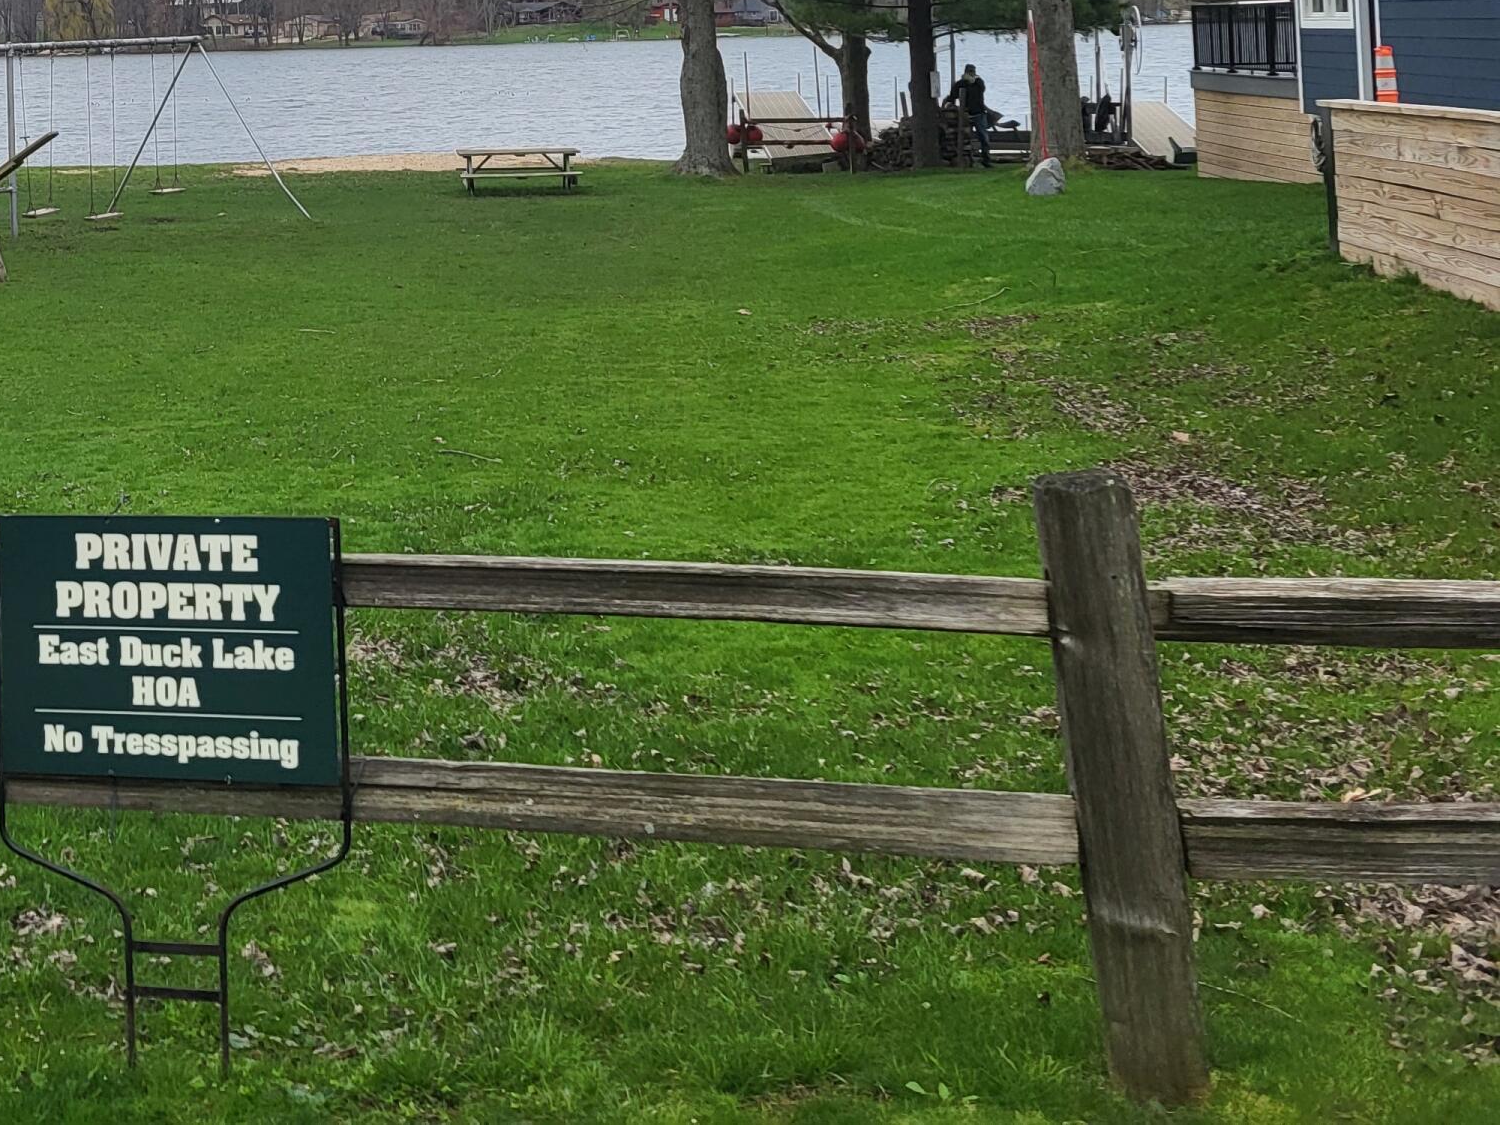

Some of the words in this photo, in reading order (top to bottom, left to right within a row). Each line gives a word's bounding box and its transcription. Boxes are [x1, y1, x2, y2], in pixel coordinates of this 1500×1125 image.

[75, 532, 259, 572] PRIVATE
[55, 580, 281, 622] PROPERTY
[38, 634, 110, 666] East
[119, 635, 203, 668] Duck
[212, 638, 296, 671] Lake
[132, 675, 201, 708] HOA
[43, 724, 84, 753] No
[91, 725, 300, 770] Tresspassing
